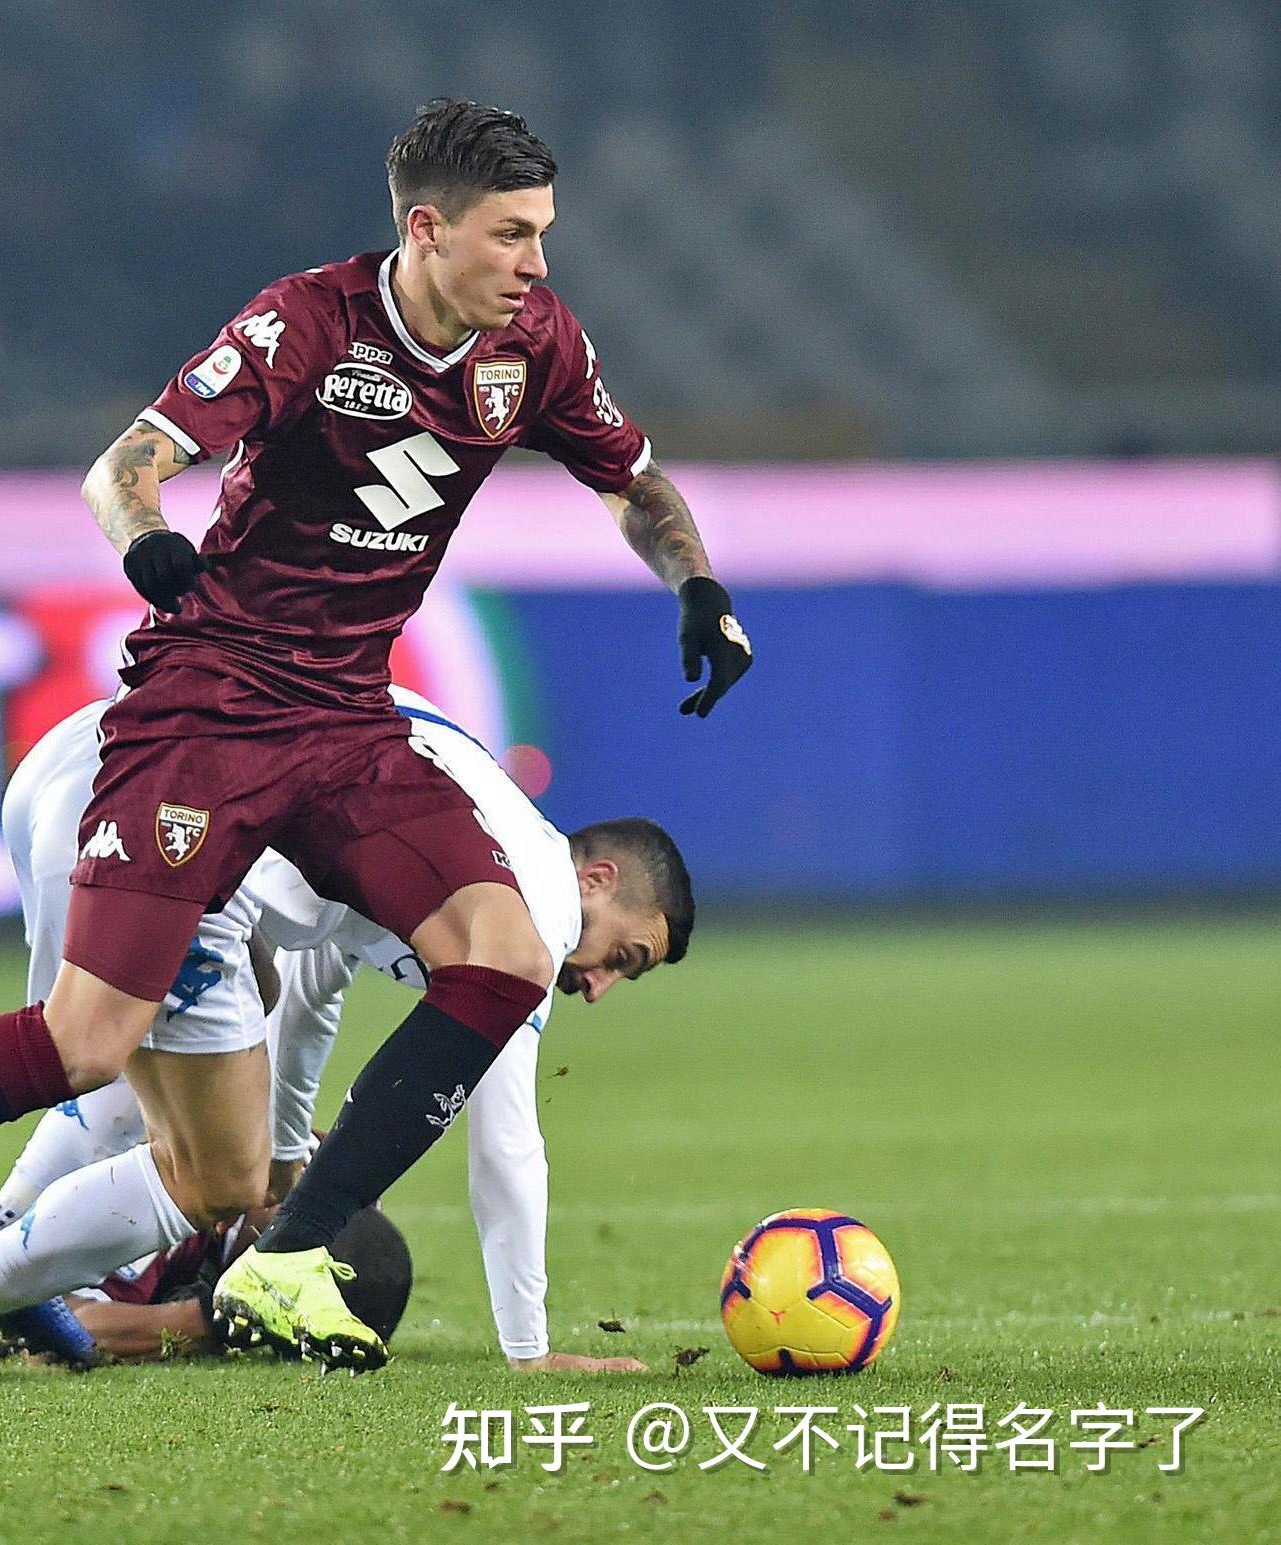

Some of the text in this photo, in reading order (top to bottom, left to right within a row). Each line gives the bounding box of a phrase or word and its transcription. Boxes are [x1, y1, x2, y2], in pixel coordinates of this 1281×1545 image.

[348, 342, 394, 365] ppa
[479, 368, 521, 381] TORINO
[504, 384, 520, 396] FC
[329, 522, 430, 552] SUZUKI
[164, 809, 203, 824] TORINO
[186, 826, 202, 838] FC
